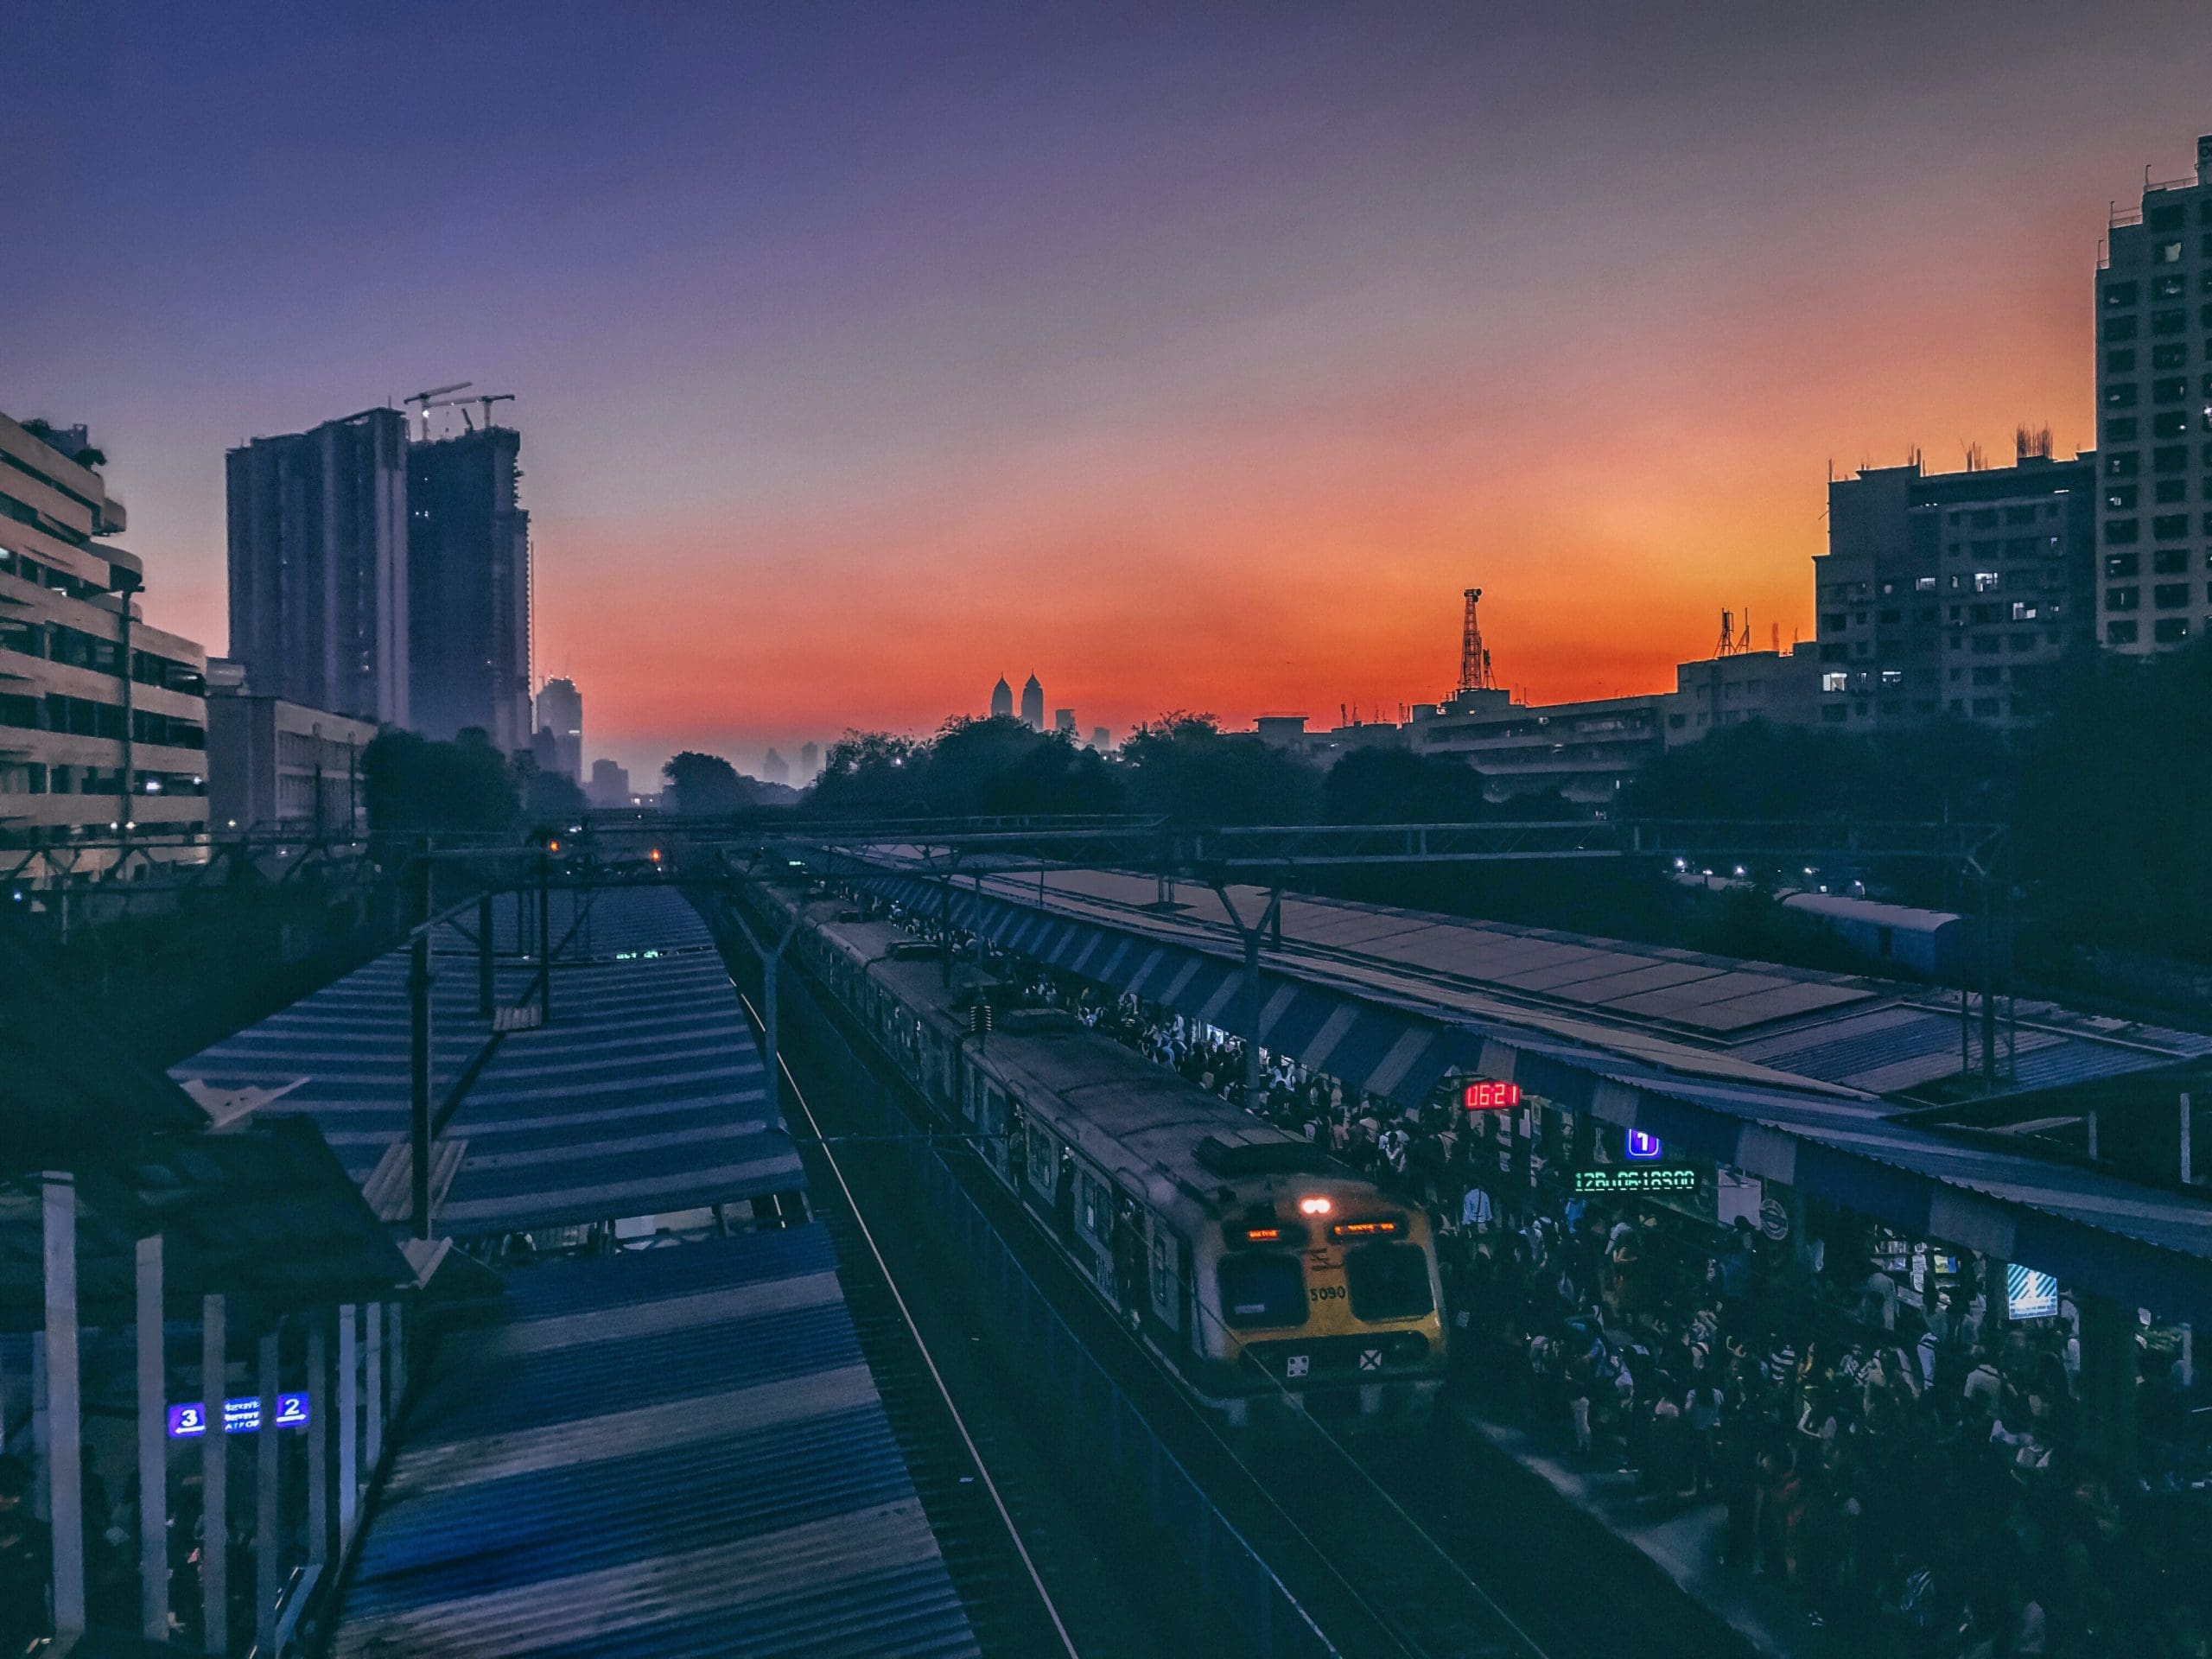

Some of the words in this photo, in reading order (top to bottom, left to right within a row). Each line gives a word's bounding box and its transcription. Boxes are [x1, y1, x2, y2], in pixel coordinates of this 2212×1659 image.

[1637, 1132, 1649, 1151] 1
[1309, 1285, 1346, 1301] 5090
[284, 1398, 300, 1416] 2
[181, 1408, 198, 1427] 3
